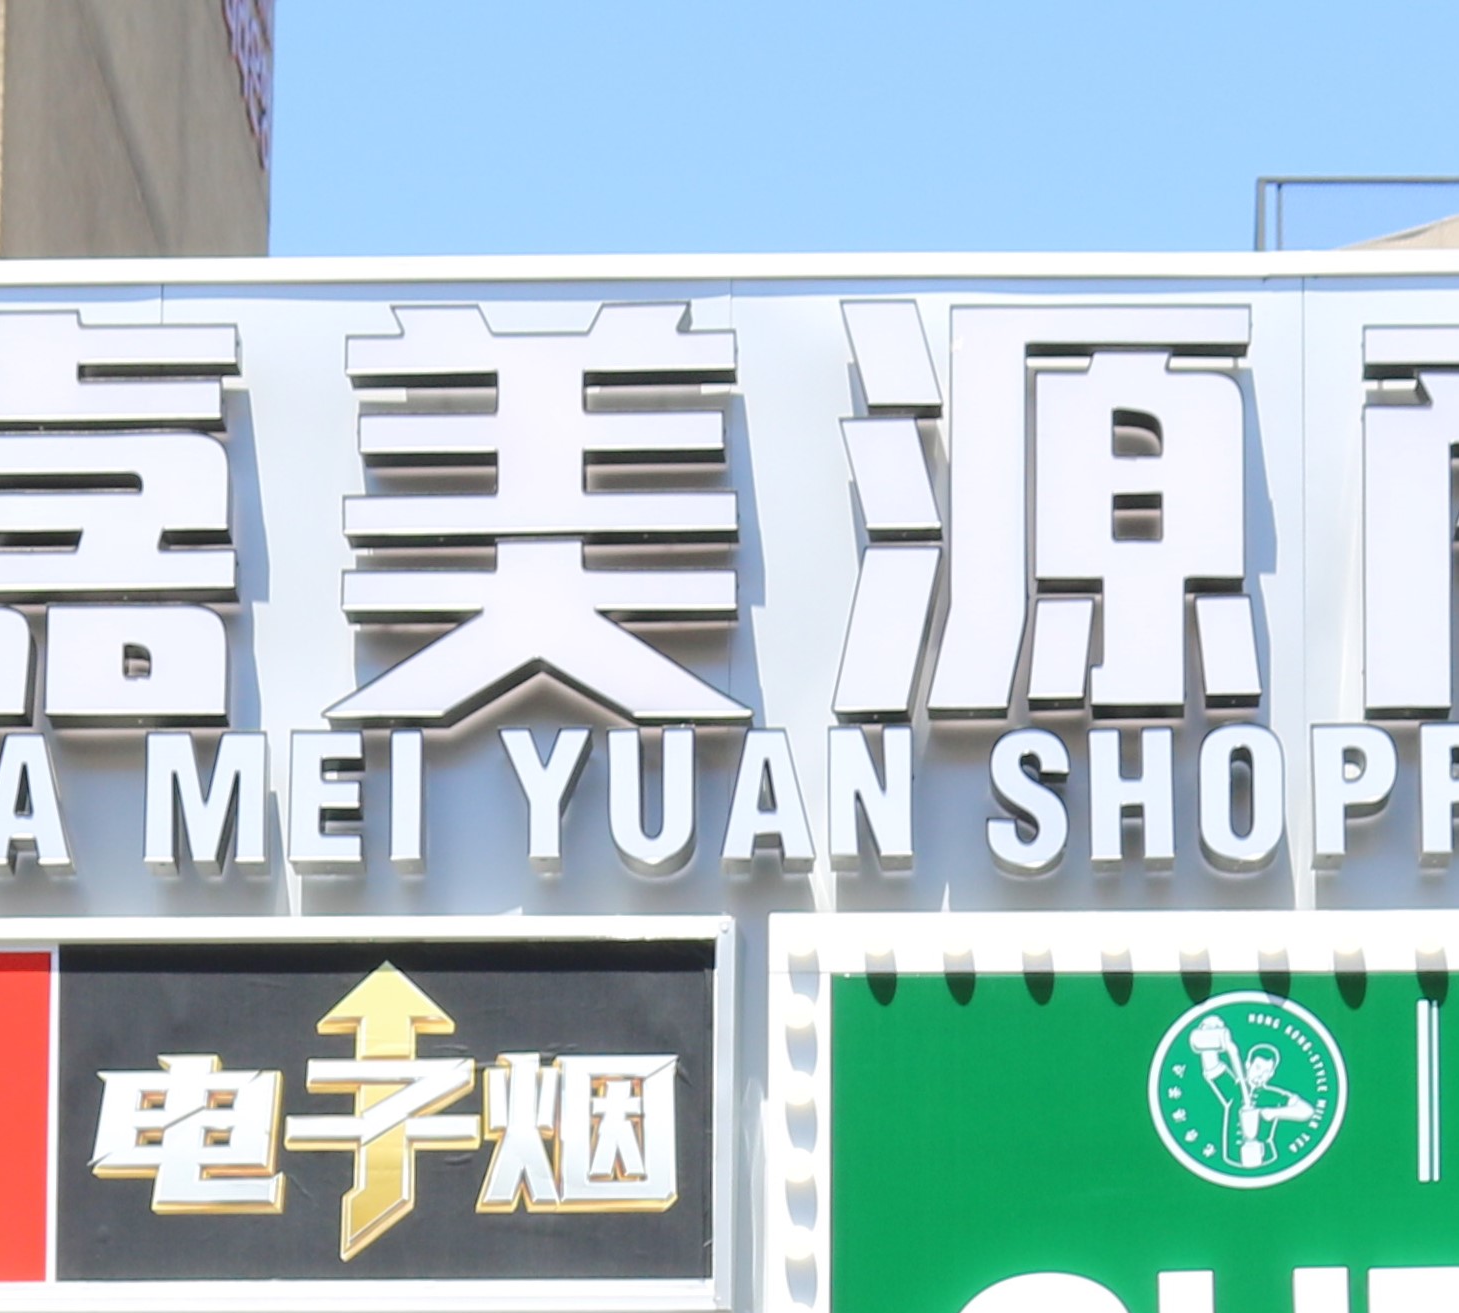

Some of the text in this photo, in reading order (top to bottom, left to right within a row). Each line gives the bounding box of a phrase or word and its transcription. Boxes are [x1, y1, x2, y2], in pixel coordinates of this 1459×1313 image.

[142, 730, 426, 875] MEI
[499, 727, 915, 873] YUAN
[93, 961, 679, 1262] 电子烟
